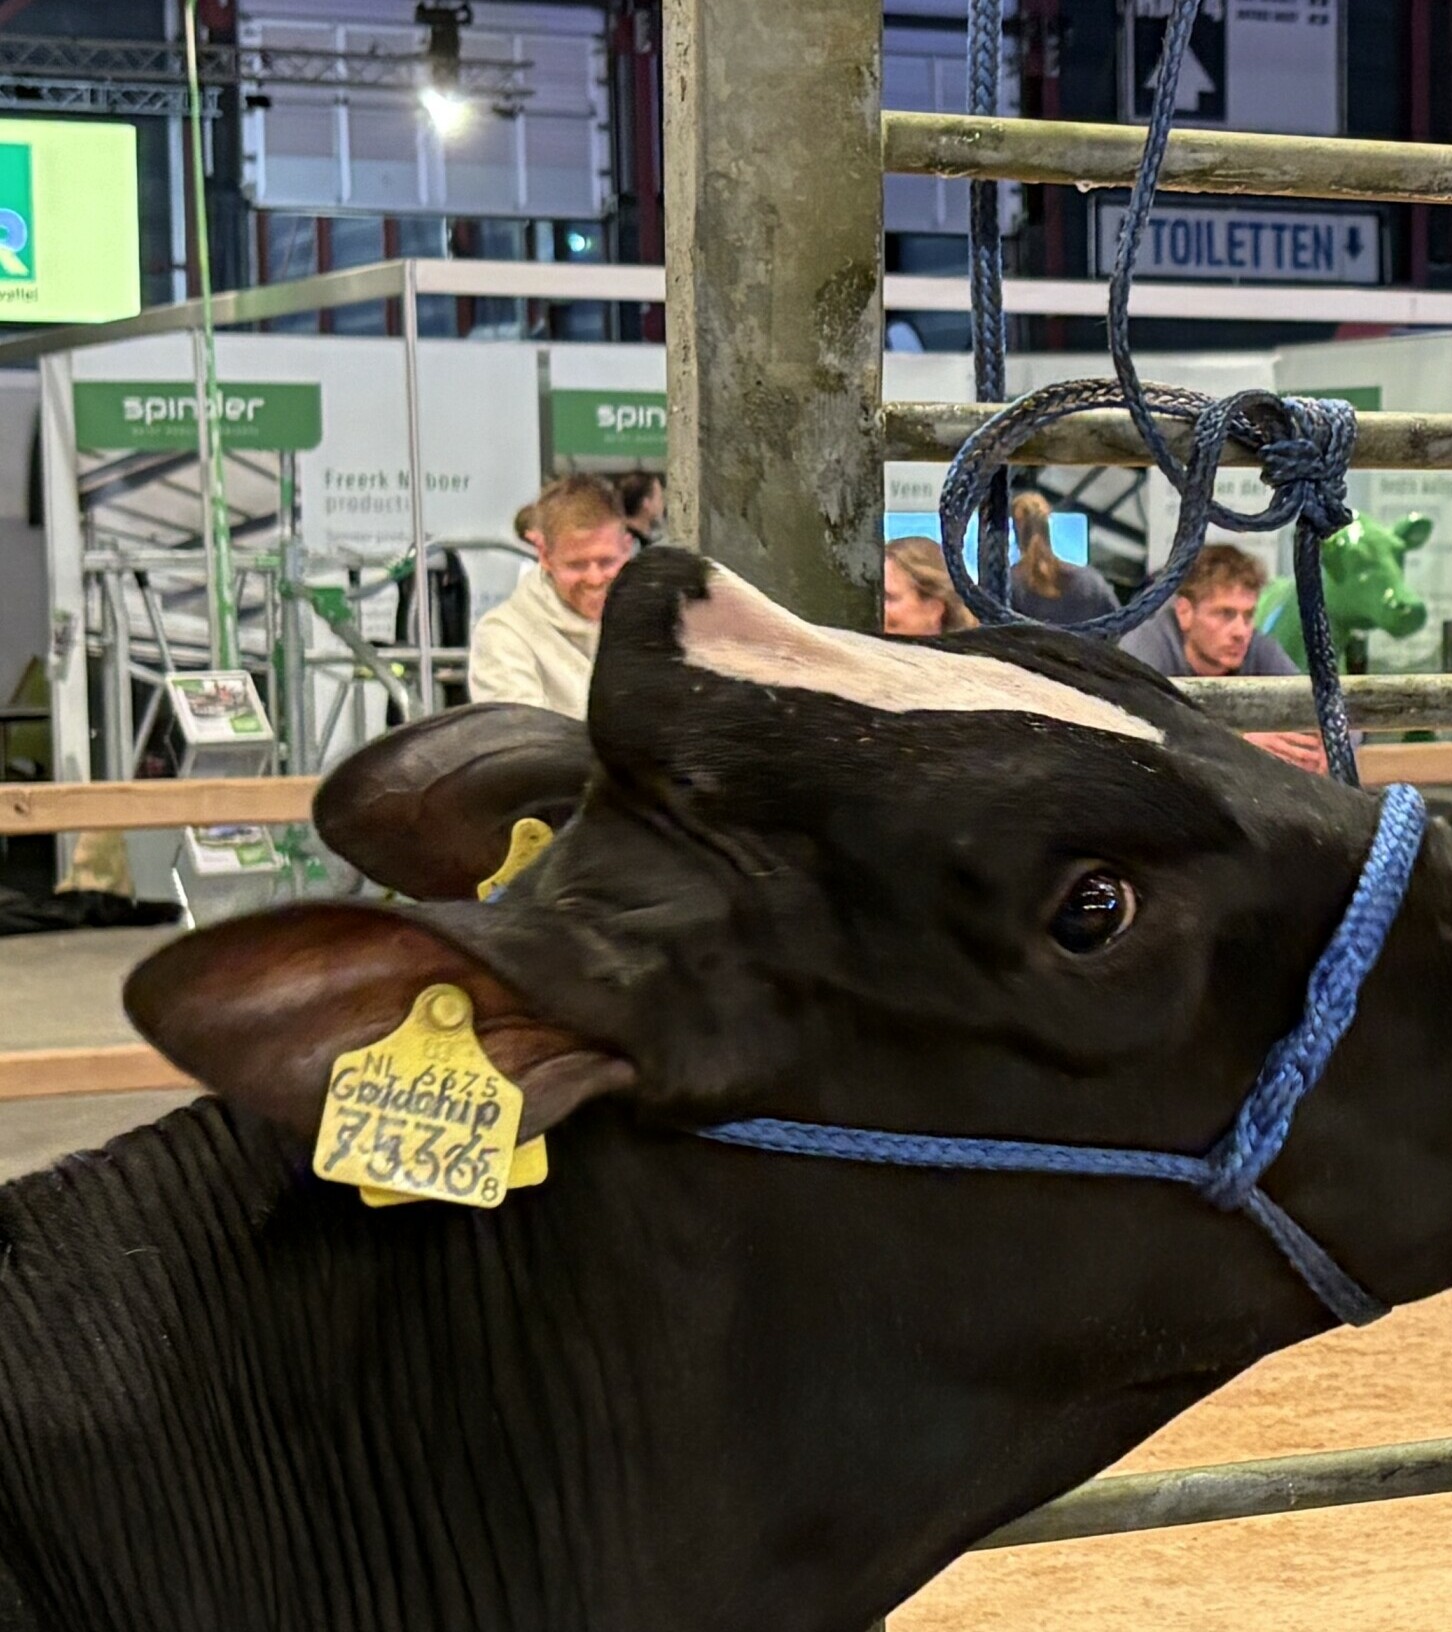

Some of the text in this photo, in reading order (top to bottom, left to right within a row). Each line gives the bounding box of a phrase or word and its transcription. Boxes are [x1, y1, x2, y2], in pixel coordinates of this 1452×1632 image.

[1148, 217, 1335, 271] TOILETTEN
[597, 404, 666, 432] spin
[325, 469, 470, 493] Freerk Nboer
[325, 495, 411, 515] producti
[331, 1066, 500, 1134] Goldchip
